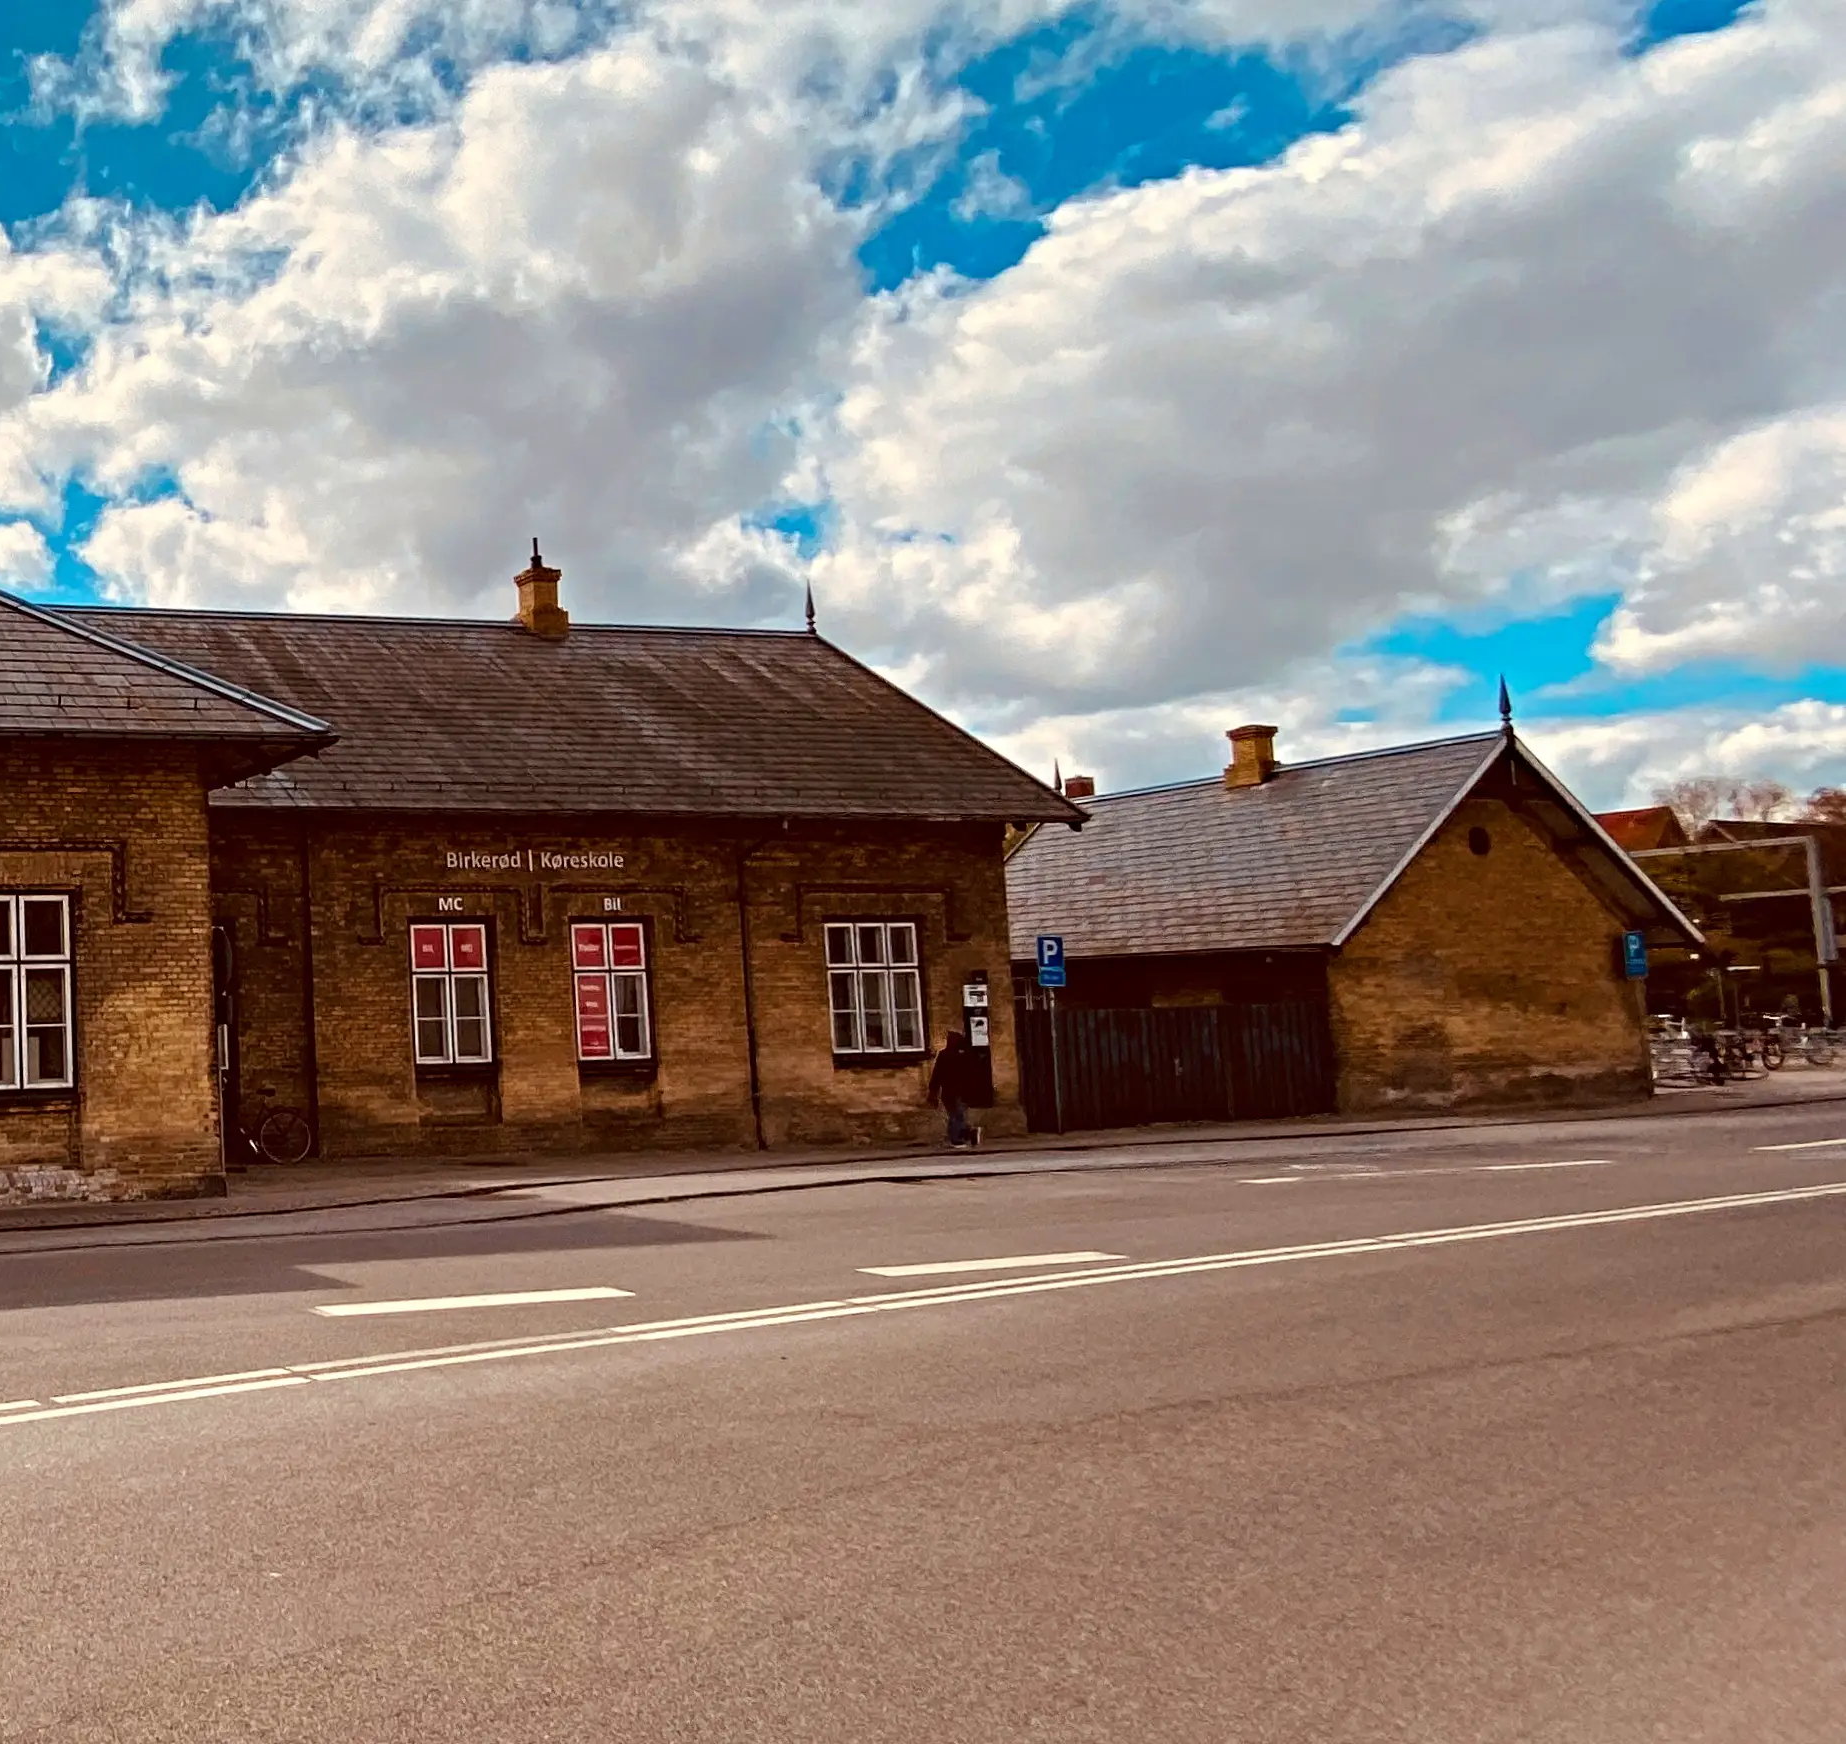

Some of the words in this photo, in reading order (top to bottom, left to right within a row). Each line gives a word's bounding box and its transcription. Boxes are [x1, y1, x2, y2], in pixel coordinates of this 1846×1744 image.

[446, 850, 521, 869] Birkerød
[540, 851, 624, 869] Køreskole
[438, 897, 464, 911] MC
[603, 897, 621, 911] Bil
[1043, 940, 1058, 964] P
[1628, 935, 1640, 957] P
